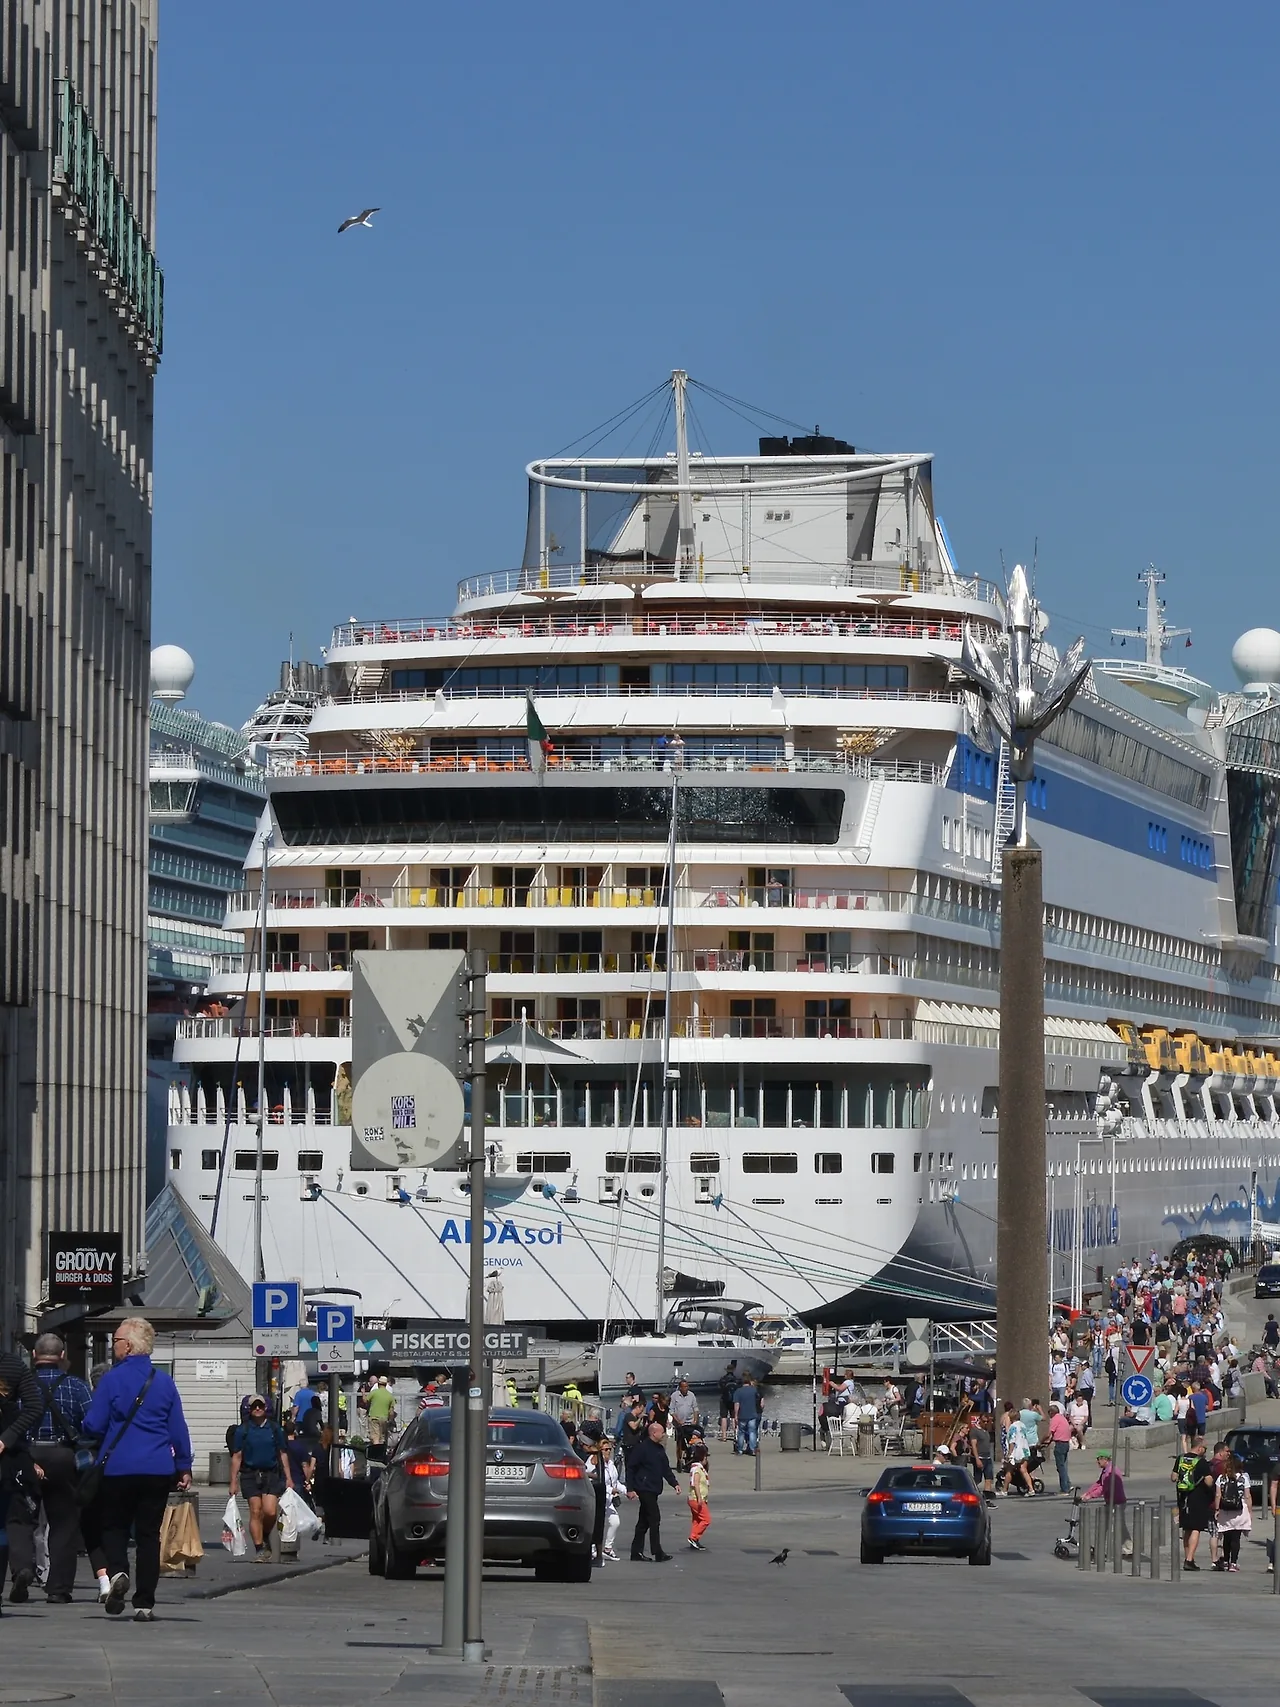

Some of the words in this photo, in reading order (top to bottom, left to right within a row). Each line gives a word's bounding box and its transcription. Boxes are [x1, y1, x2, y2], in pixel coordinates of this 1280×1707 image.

[392, 1096, 414, 1109] KORS
[393, 1116, 416, 1128] MILE
[55, 1251, 117, 1271] GROOVY
[483, 1258, 523, 1267] GENOVA
[55, 1272, 83, 1283] BURGER
[84, 1273, 91, 1283] &
[93, 1273, 113, 1283] DOGS
[265, 1289, 288, 1324] P
[327, 1311, 346, 1338] P
[391, 1333, 523, 1350] FISKETOGET
